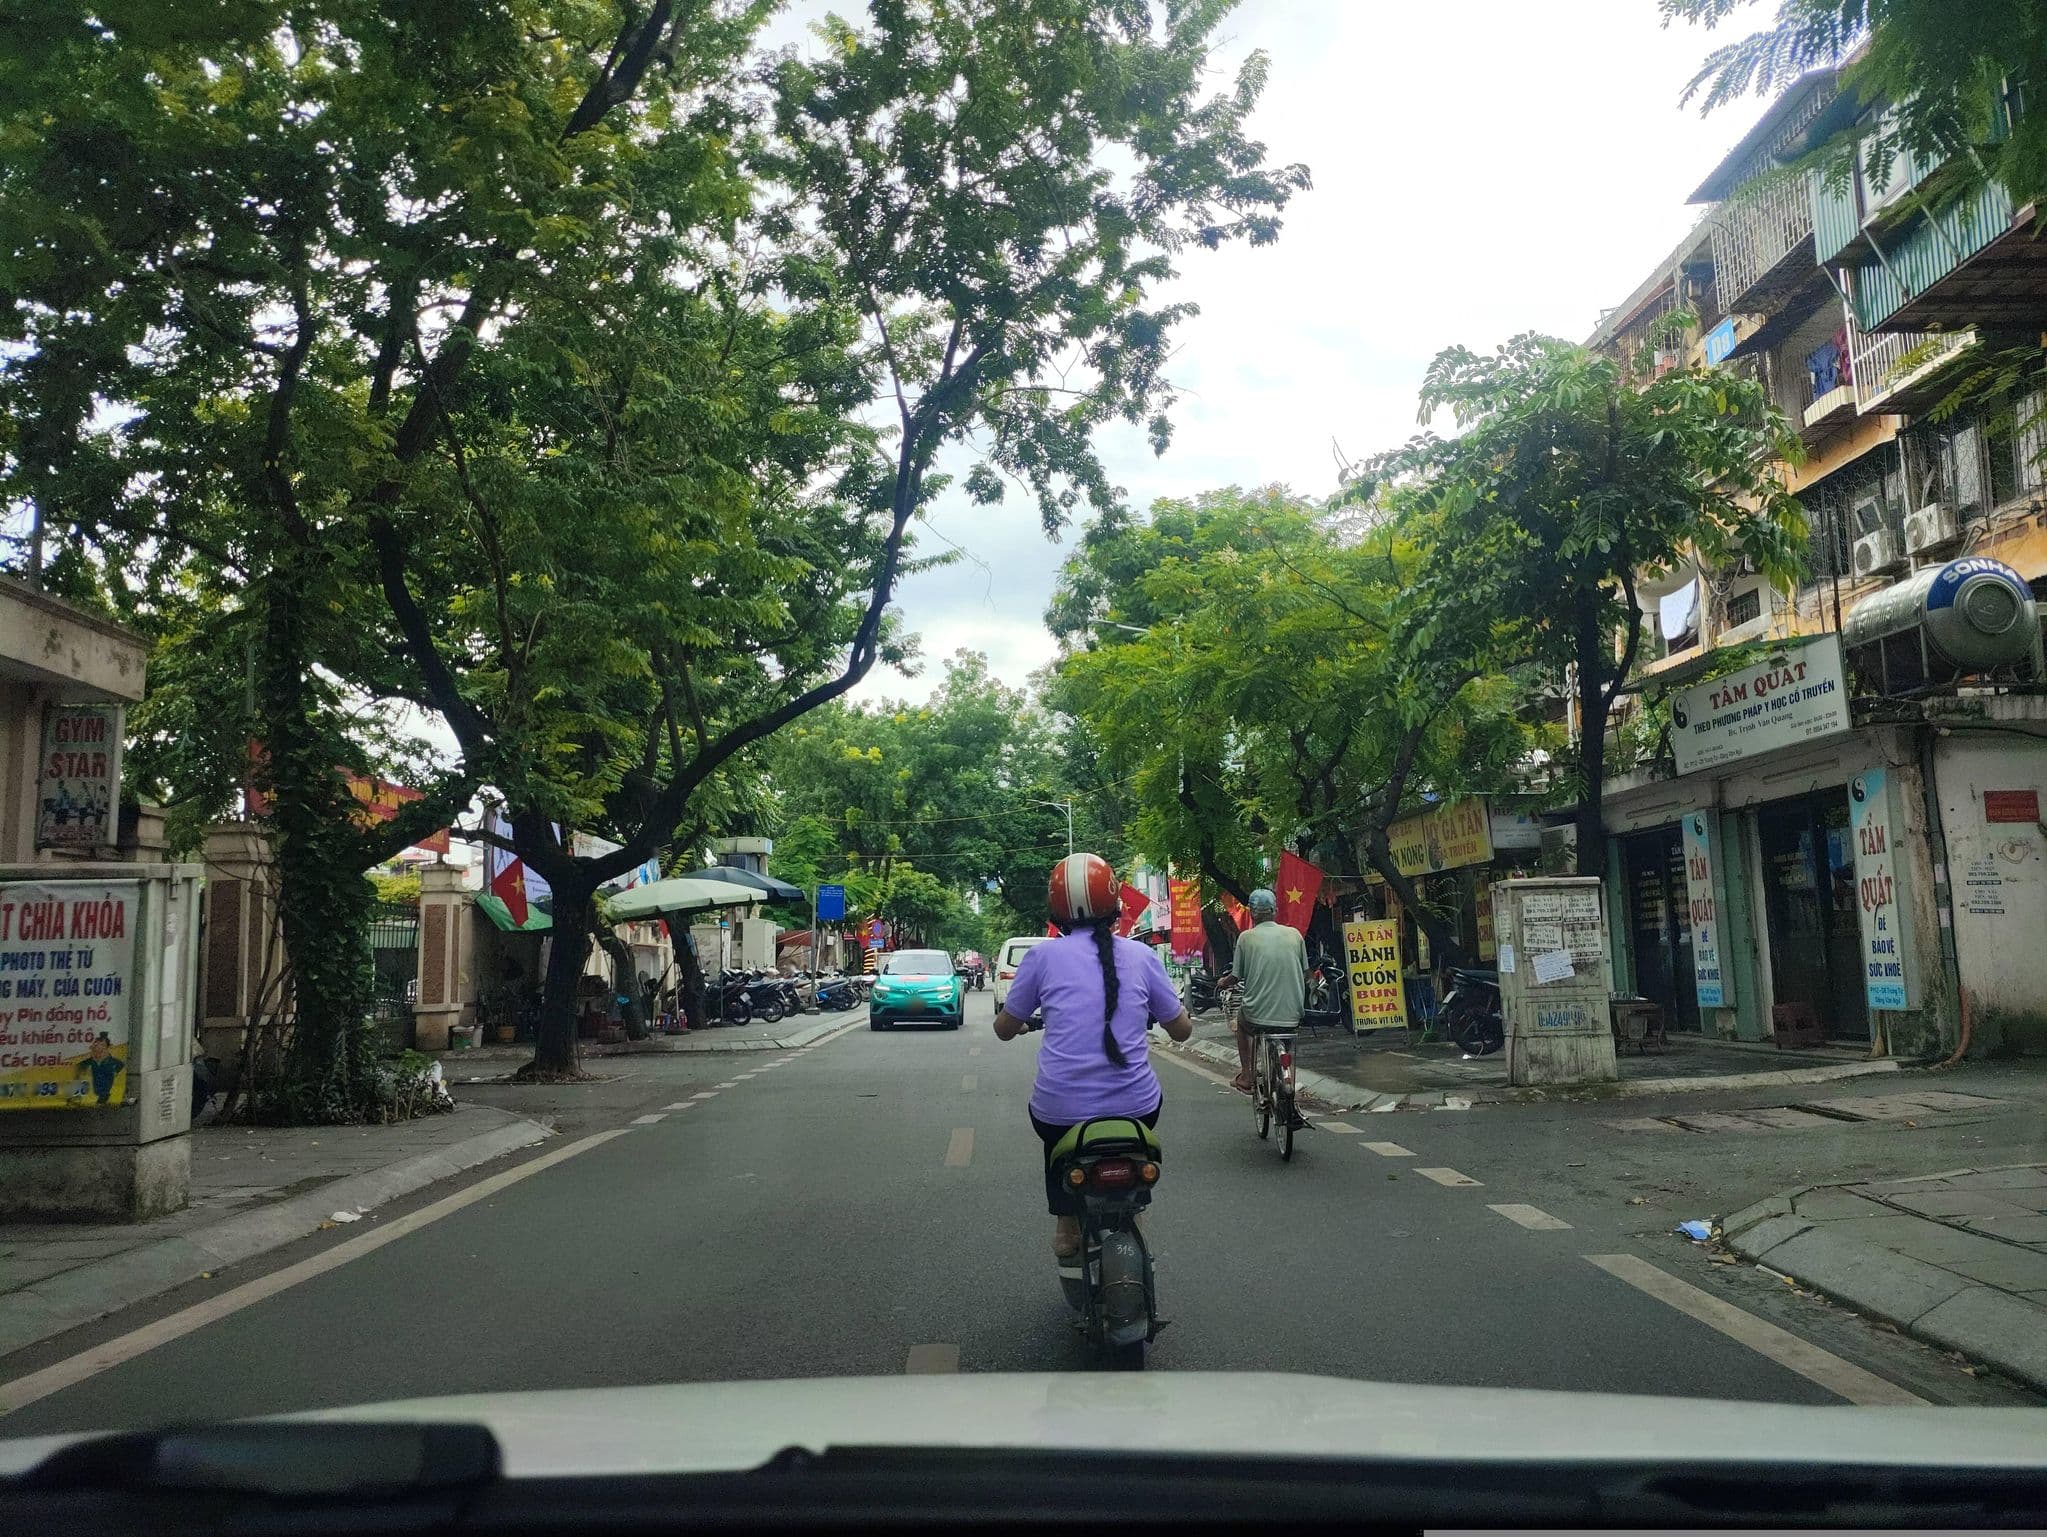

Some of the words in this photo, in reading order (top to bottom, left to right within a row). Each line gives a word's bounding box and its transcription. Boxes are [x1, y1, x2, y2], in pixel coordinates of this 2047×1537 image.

[1694, 718, 1711, 735] THEO
[1712, 711, 1741, 729] PHƯƠNG
[1742, 703, 1763, 720] PHÁP
[1764, 701, 1771, 712] Y
[1771, 696, 1787, 712] HỌC
[1789, 686, 1800, 705] CỔ
[1801, 677, 1835, 701] TRUYỀN
[1710, 679, 1748, 710] TẨM
[55, 717, 105, 742] GYM
[49, 752, 106, 778] STAR
[1860, 812, 1887, 856] TẨM
[1401, 840, 1424, 867] NÓNG
[1689, 846, 1708, 880] TẨM
[1861, 863, 1894, 912] QUẤT
[1691, 888, 1713, 927] QUẤT
[1347, 928, 1364, 943] GÀ
[1367, 924, 1393, 942] TẦN
[0, 951, 45, 971] PHOTO
[50, 943, 73, 970] THẺ
[77, 944, 95, 969] TỪ
[1349, 944, 1395, 964] BÁNH
[84, 971, 122, 997] CUỐN
[1352, 963, 1397, 987] CUỐN
[1356, 986, 1397, 999] BÚN
[1358, 998, 1399, 1013] CHẢ
[18, 1007, 42, 1022] Pin
[1356, 1015, 1377, 1027] TRỨNG
[1380, 1015, 1389, 1026] VỊT
